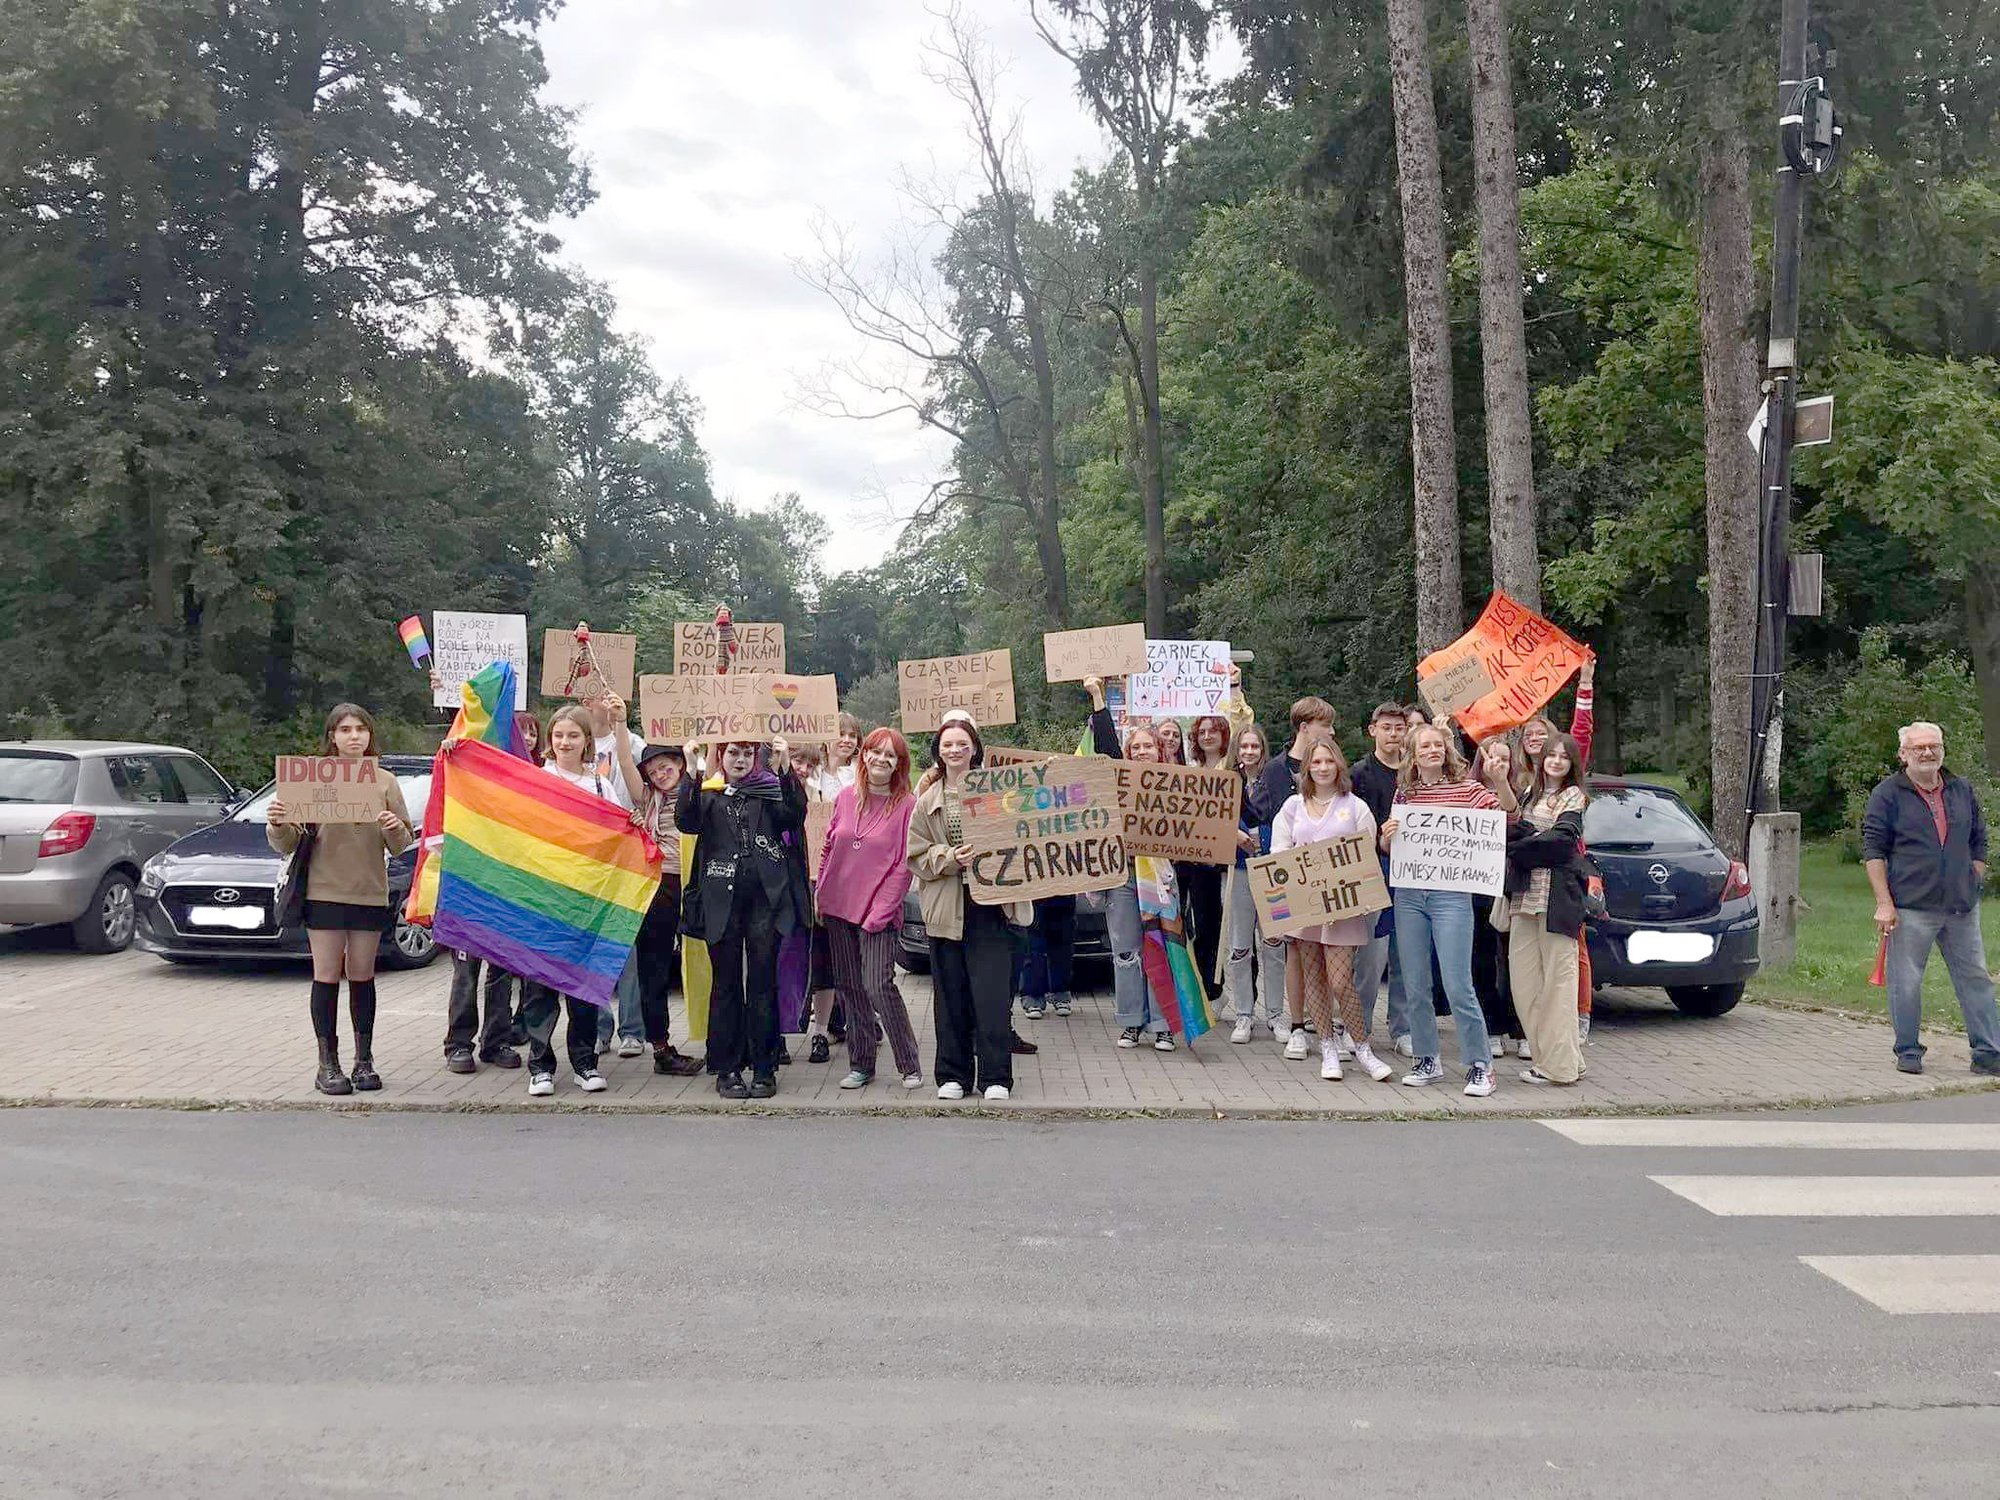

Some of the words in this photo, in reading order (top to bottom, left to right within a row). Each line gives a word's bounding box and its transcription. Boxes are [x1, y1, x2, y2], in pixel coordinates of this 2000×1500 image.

[682, 624, 775, 644] CZANEK
[439, 640, 469, 651] DOLE
[476, 641, 514, 656] POLNE
[682, 642, 781, 660] RODYNKAMI
[1147, 645, 1210, 660] ZARNEK
[905, 655, 996, 678] CZARNEK
[650, 676, 764, 697] CZARNEK
[934, 677, 958, 696] JE
[1136, 675, 1159, 688] NIE
[1174, 676, 1227, 688] CHCEMY
[1496, 640, 1583, 722] MINISTRA
[907, 693, 982, 712] NUTELLE
[651, 713, 836, 738] NIEPRZYGOTOWANIE
[278, 757, 377, 783] IDIOTA
[964, 764, 1049, 794] SZKOŁY
[1140, 770, 1235, 799] CZARNKI
[285, 802, 373, 820] PATRIOTA
[1135, 792, 1234, 820] NASZYCH
[1016, 820, 1030, 838] A
[1405, 812, 1499, 838] CZARNEK
[972, 835, 1125, 886] CZARNE(K)
[1151, 843, 1213, 859] STAWSKA
[1423, 848, 1433, 857] W
